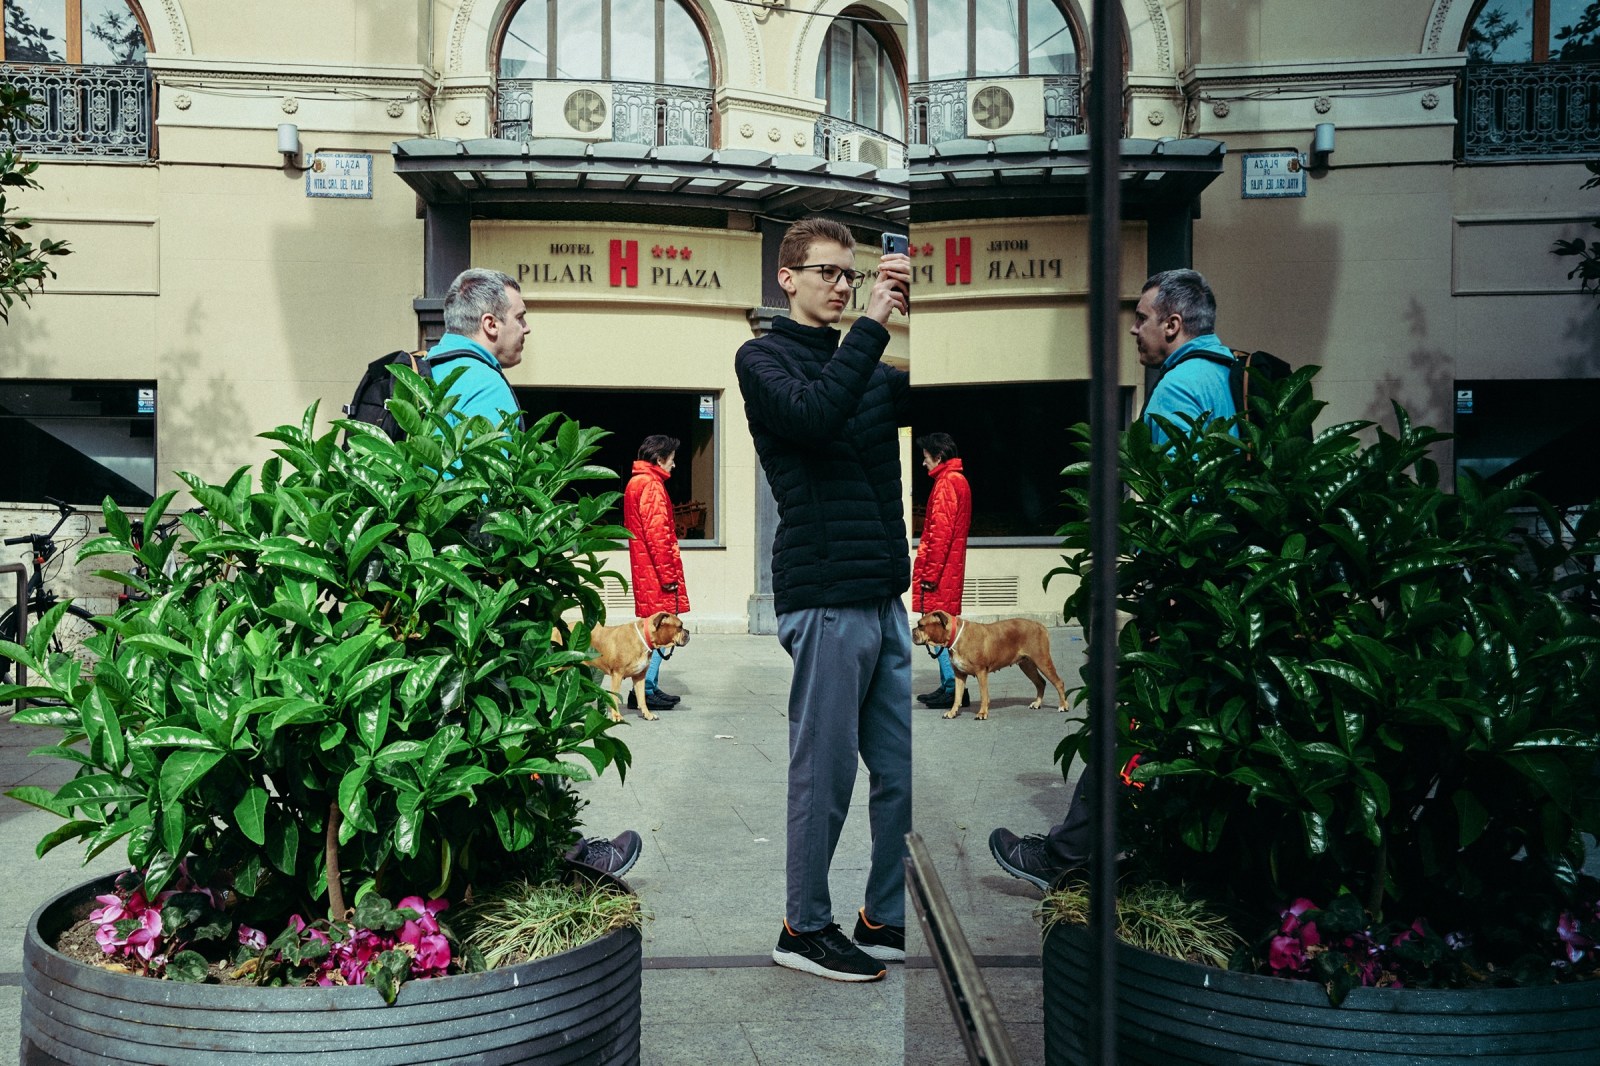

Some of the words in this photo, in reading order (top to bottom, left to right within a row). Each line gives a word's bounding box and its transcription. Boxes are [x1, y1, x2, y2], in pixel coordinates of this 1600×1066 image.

[335, 159, 360, 169] PLAZA
[340, 179, 348, 190] DEL
[350, 179, 364, 190] PILAR
[549, 243, 594, 255] HOTEL
[609, 238, 639, 288] H
[517, 263, 593, 283] PILAR
[651, 265, 721, 289] PLAZA
